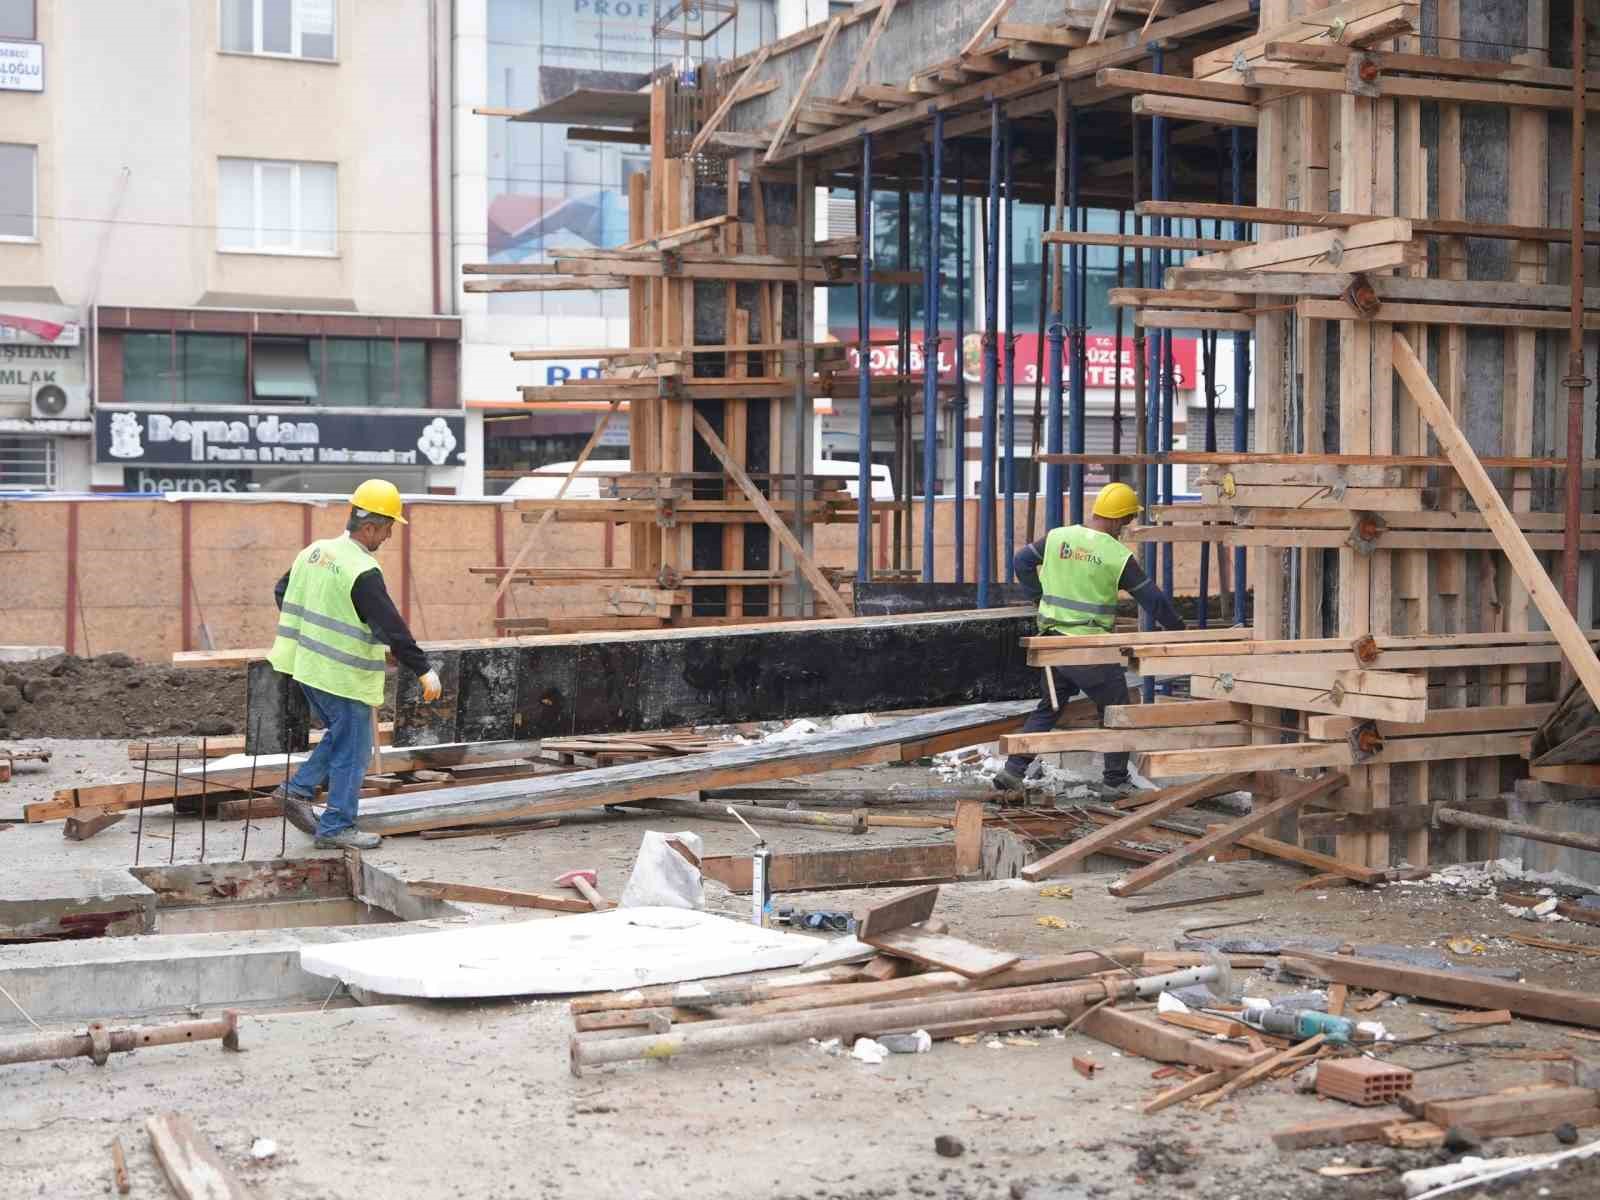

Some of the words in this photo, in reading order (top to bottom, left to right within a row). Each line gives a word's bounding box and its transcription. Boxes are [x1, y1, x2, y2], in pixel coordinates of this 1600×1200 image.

[0, 61, 40, 76] LOĞLU
[849, 345, 952, 372] TOMBL
[1084, 348, 1130, 365] ÜZCE
